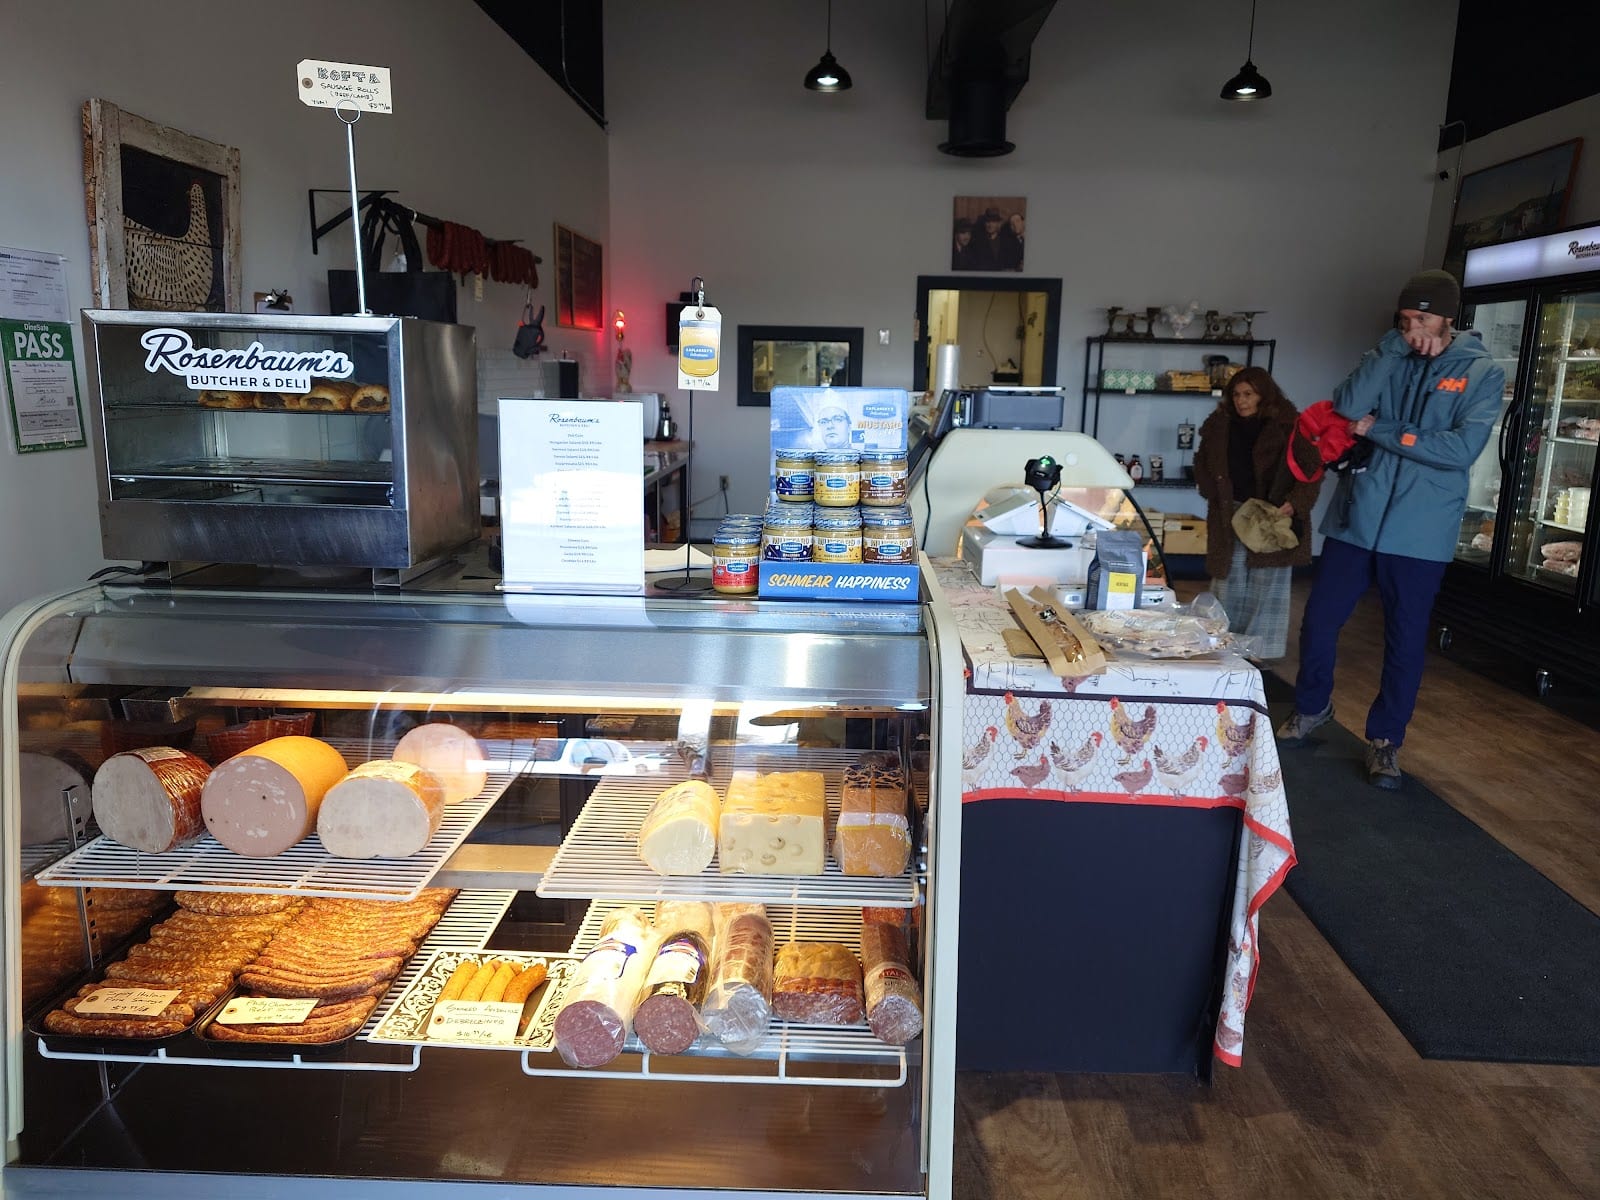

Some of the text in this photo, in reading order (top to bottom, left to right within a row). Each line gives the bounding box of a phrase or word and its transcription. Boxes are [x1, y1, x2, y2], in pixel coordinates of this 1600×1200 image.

[320, 82, 379, 94] SAUSAGE ROLLS
[13, 331, 64, 358] PASS
[145, 333, 349, 372] Rosenbaum's
[191, 375, 307, 389] BUTCHER & DELI
[549, 413, 601, 424] Rosenbaum's
[857, 420, 903, 430] MUSTARD
[768, 573, 911, 590] SCHMEAR HAPPINESS
